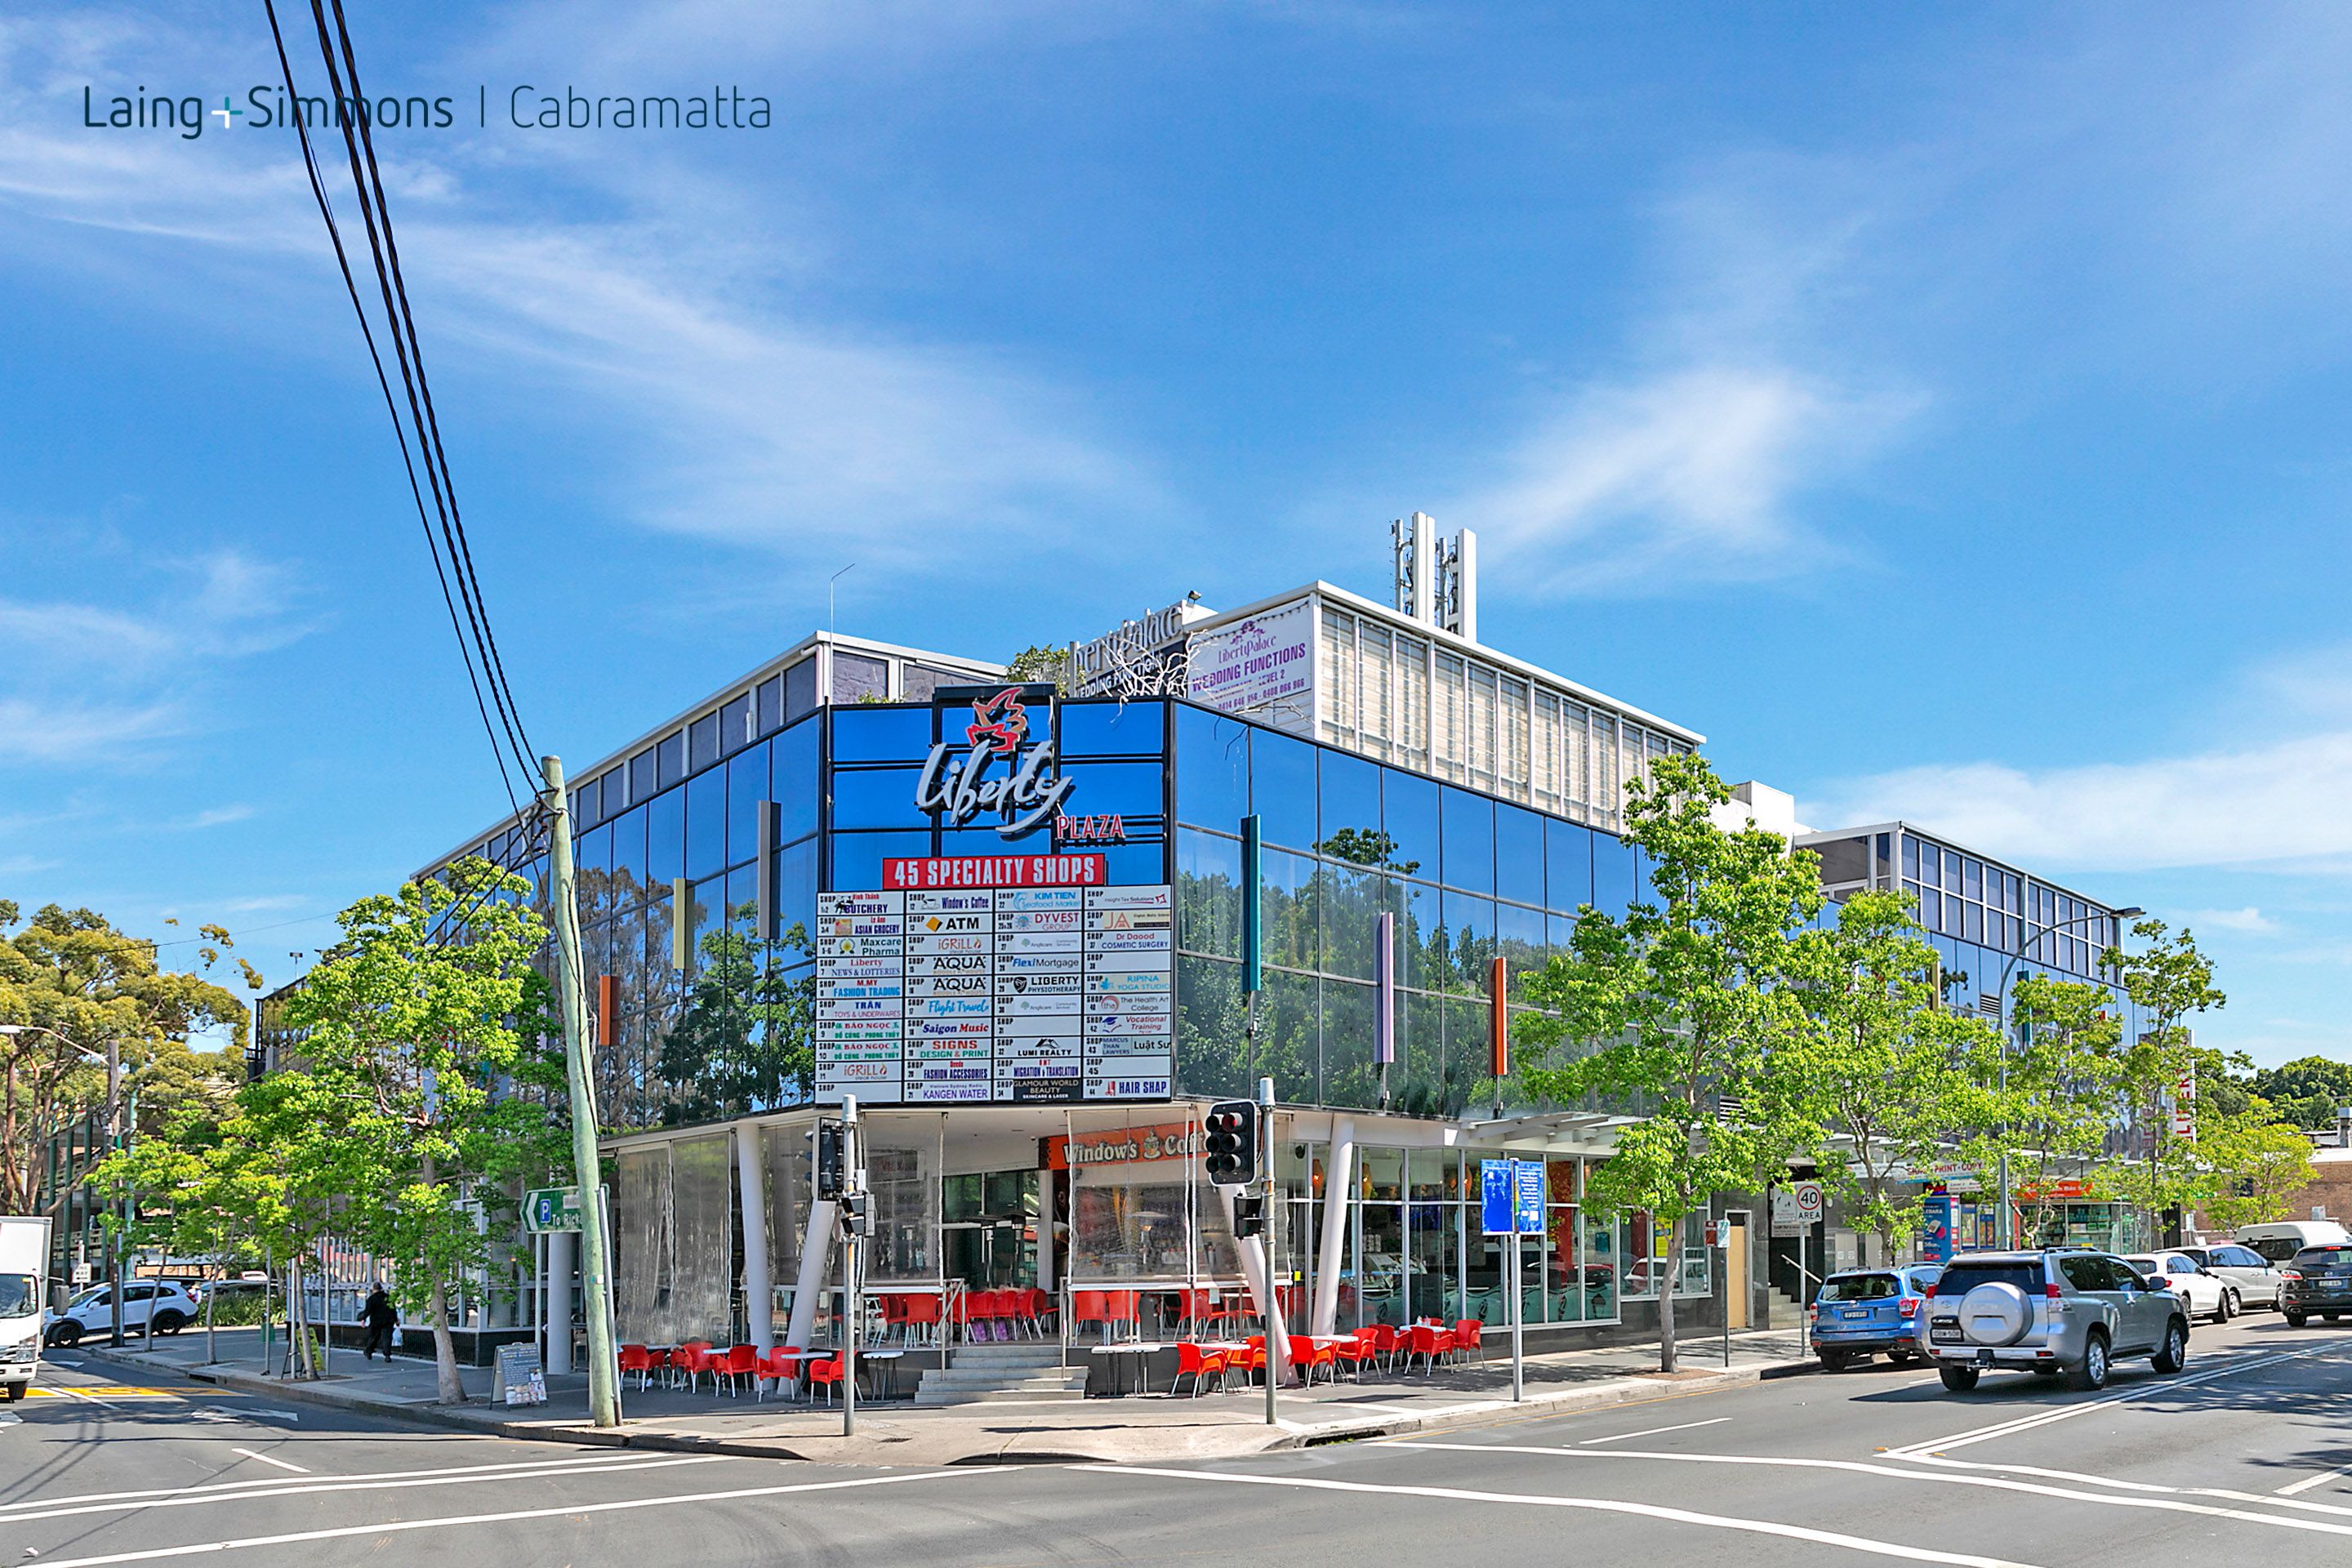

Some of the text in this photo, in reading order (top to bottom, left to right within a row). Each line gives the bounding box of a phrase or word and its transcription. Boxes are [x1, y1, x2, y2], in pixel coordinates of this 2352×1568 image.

[1192, 665, 1241, 693] WEDDING
[1245, 643, 1306, 675] FUNCTIONS
[1281, 670, 1285, 679] 2
[915, 740, 1073, 833] Liberty
[1057, 814, 1125, 839] PLAZA
[894, 856, 1094, 886] 45 SPECIALTY SHOPS
[844, 904, 888, 913] BUTCHERY
[942, 898, 968, 909] Window's
[946, 917, 979, 929] ATM
[1035, 913, 1080, 923] DYVEST
[862, 947, 899, 956] Pharma
[850, 959, 883, 967] Liberty
[933, 956, 986, 970] AQUA
[933, 978, 986, 991] AQUA
[1031, 976, 1079, 985] LIBERTY
[834, 987, 900, 996] FASHION TRADING
[929, 1000, 955, 1016] Flight
[923, 1023, 988, 1035] Saigon Music
[933, 1040, 978, 1049] SIGNS
[924, 1069, 987, 1079] FASHION ACCESSORIES
[1014, 1067, 1040, 1077] MIGRATION
[1046, 1067, 1078, 1076] TRANSLATION
[1119, 1081, 1166, 1094] HAIR SHAP
[924, 1089, 987, 1099] KANGEN WATER
[1063, 1130, 1207, 1164] Window's Coff
[1800, 1192, 1818, 1205] 40
[541, 1201, 549, 1220] P
[1798, 1211, 1820, 1220] AREA
[552, 1214, 560, 1226] To
